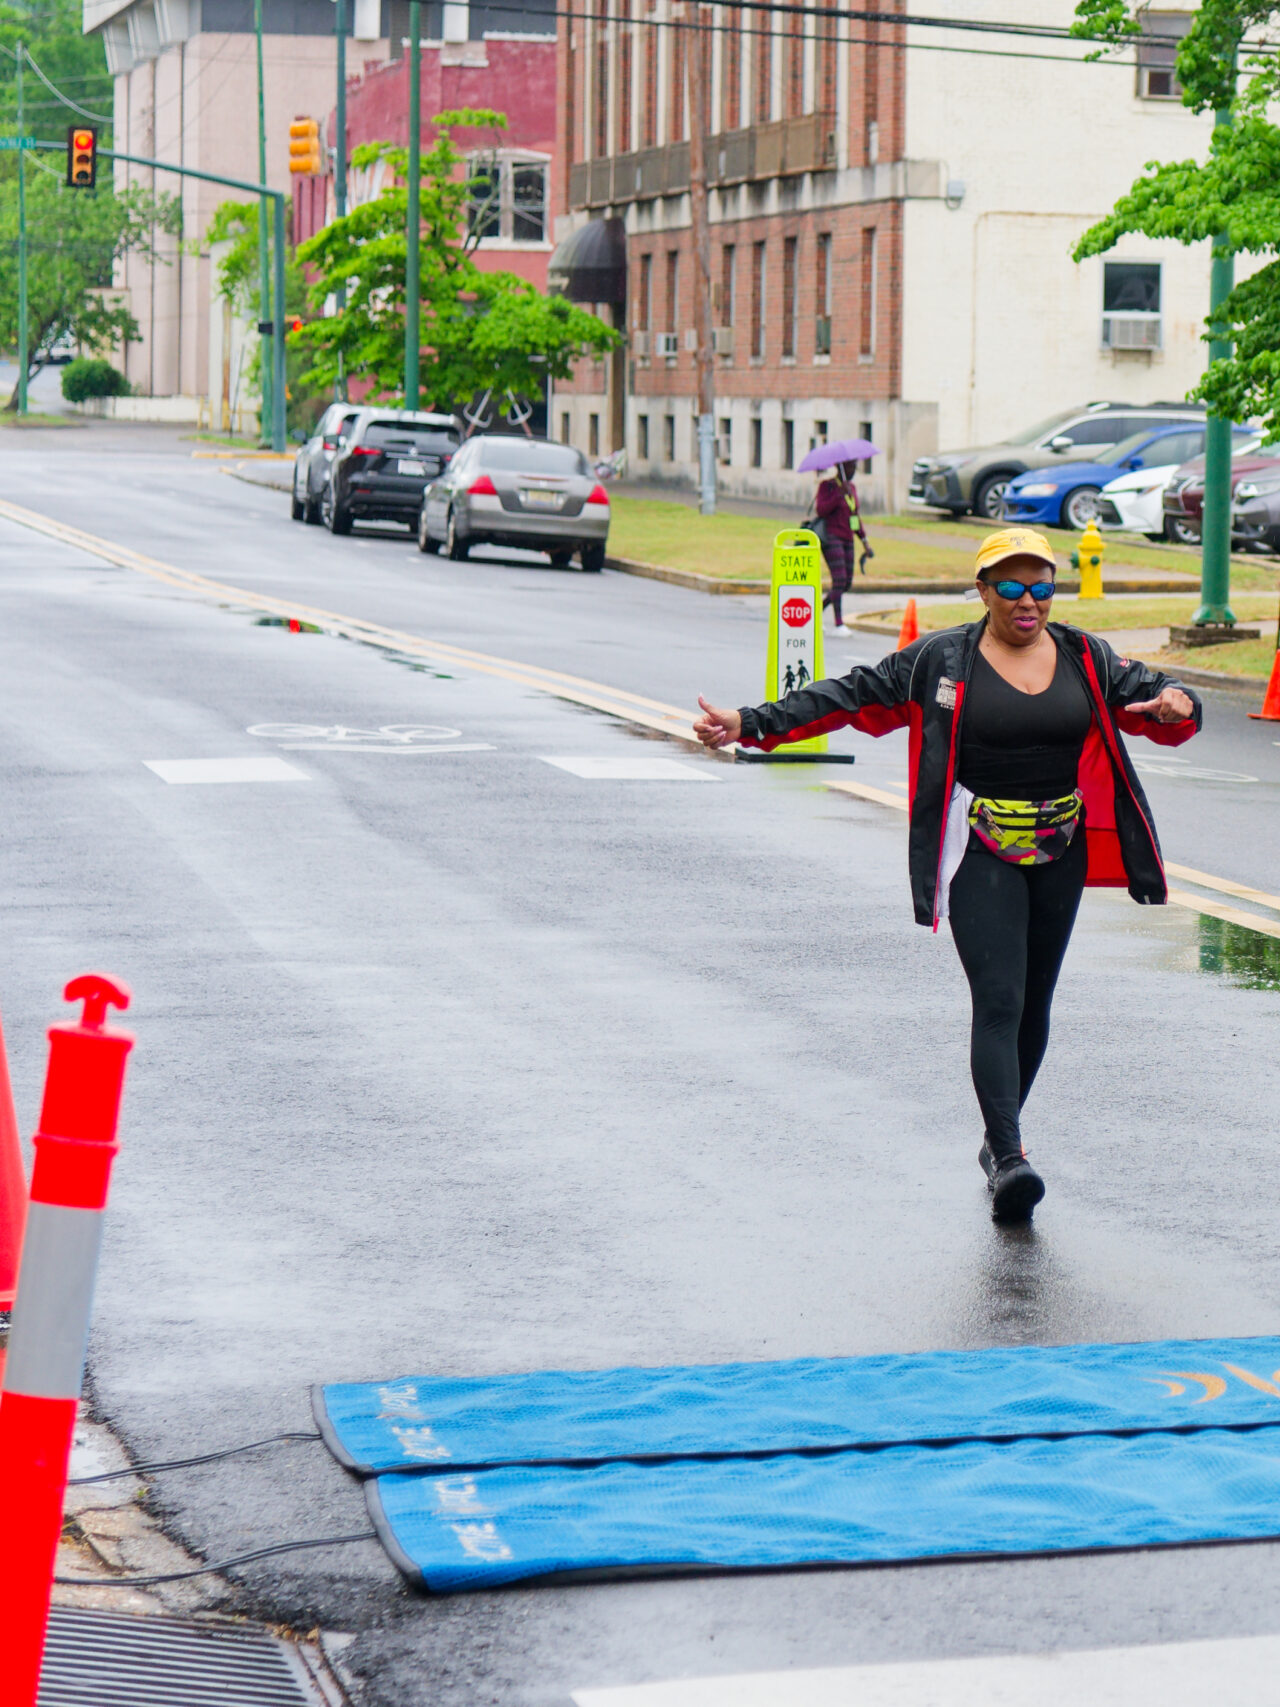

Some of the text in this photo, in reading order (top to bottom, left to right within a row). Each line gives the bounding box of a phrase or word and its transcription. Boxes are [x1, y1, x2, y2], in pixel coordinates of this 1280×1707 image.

[781, 555, 813, 567] STATE
[785, 570, 808, 582] LAW
[782, 606, 811, 619] STOP
[786, 639, 806, 648] FOR
